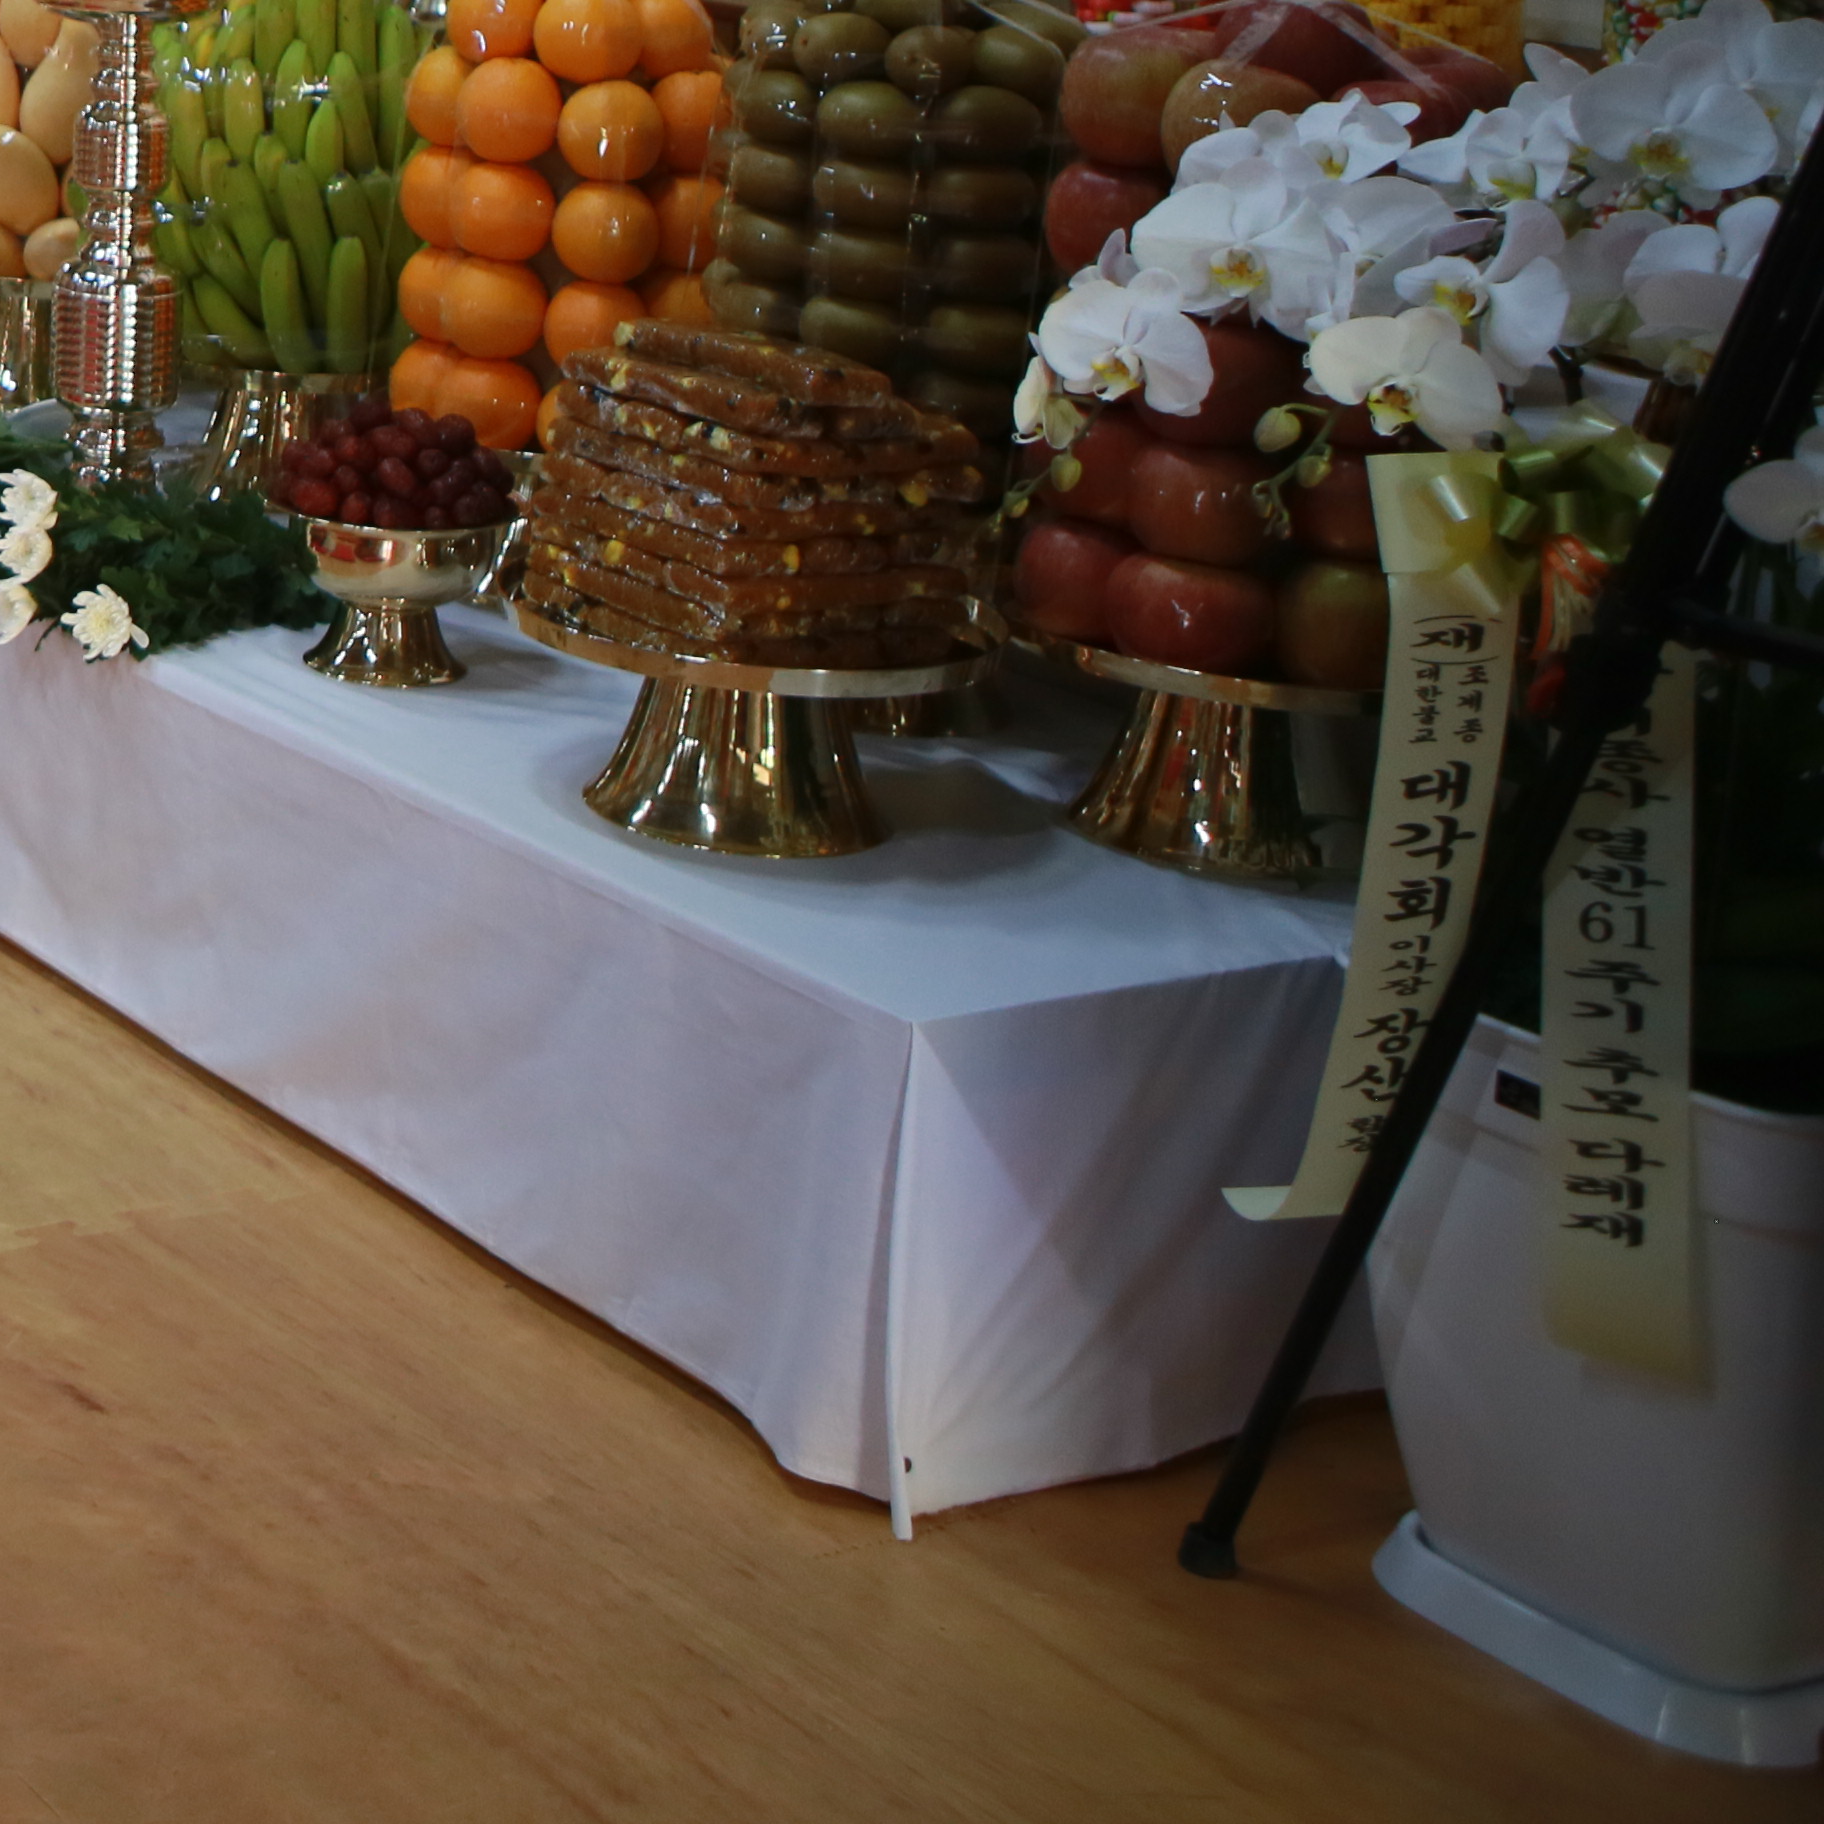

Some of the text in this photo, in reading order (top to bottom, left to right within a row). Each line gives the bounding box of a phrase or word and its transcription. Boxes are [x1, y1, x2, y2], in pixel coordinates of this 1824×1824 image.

[1407, 662, 1444, 744] 대한불교
[1452, 664, 1490, 744] 조계종
[1382, 759, 1477, 932] 대각회
[1377, 934, 1438, 997] 이사장
[1559, 1046, 1660, 1123] 추모
[1559, 1136, 1666, 1248] 다례재
